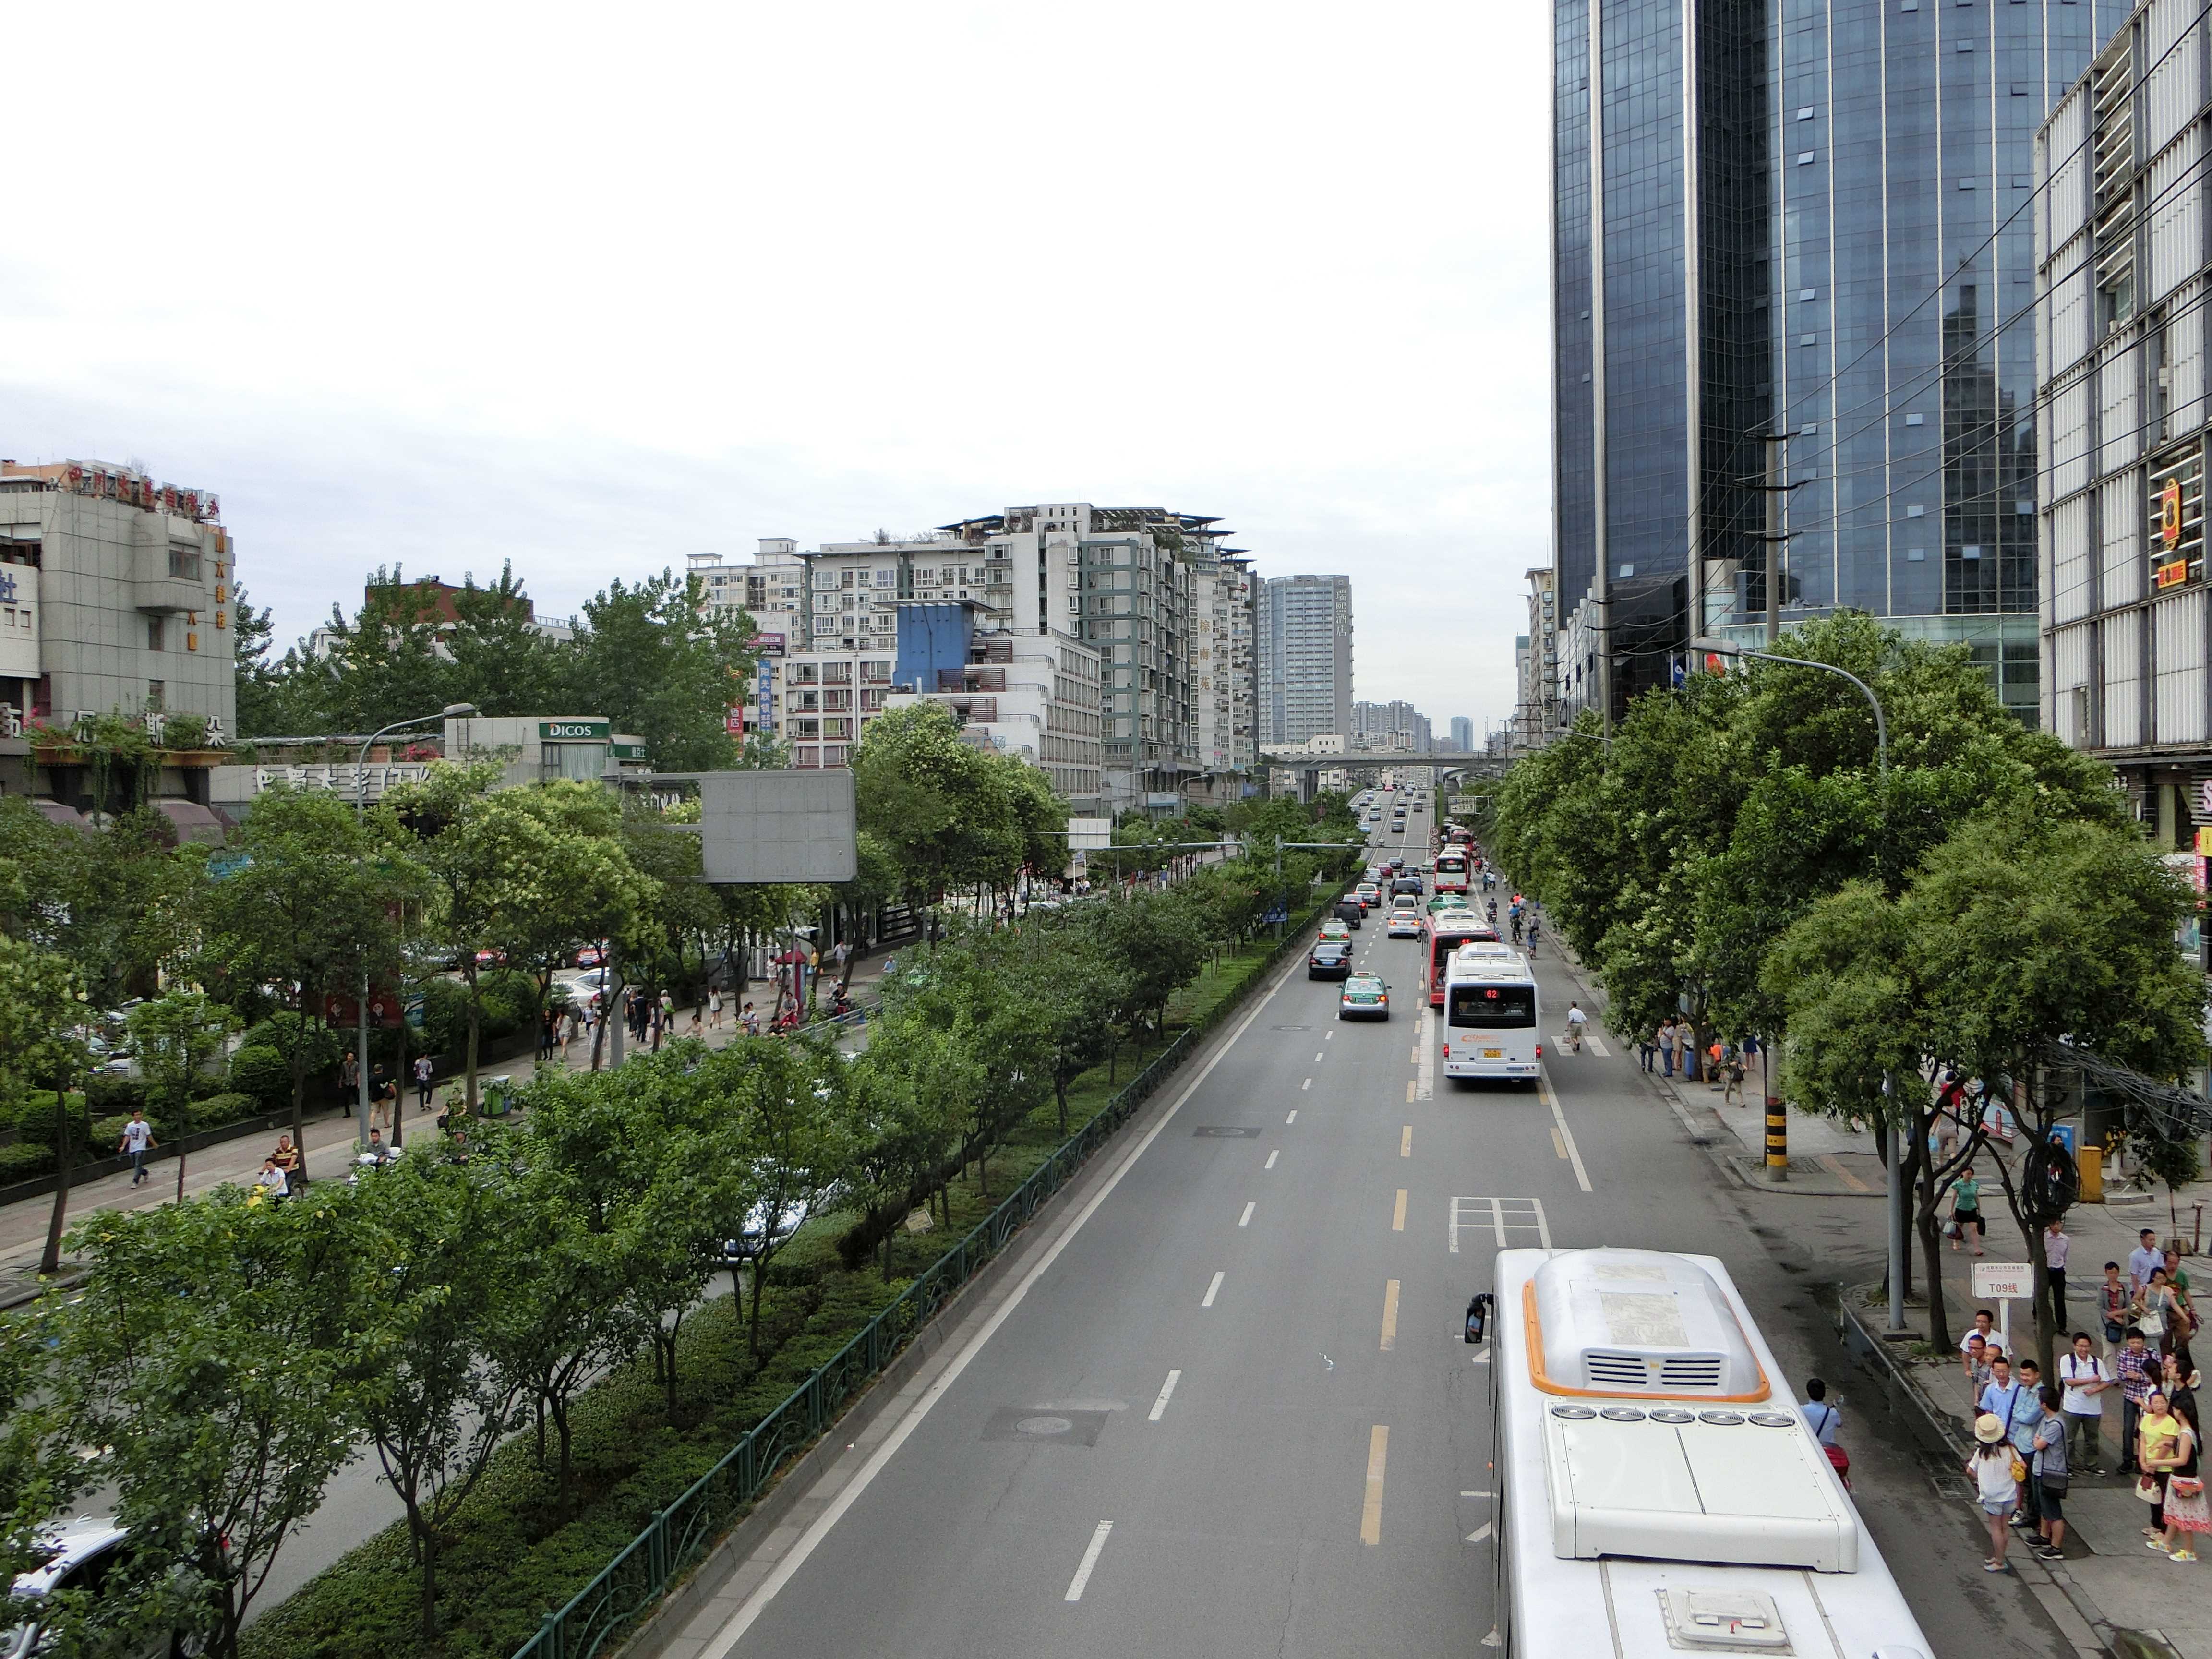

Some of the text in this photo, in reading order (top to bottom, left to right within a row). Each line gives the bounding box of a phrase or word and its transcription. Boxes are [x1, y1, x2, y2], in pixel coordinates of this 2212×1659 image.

[1199, 619, 1210, 690] 棕南苑
[550, 725, 592, 736] DICOS
[1487, 990, 1497, 998] 62
[1989, 1283, 2018, 1293] T09线
